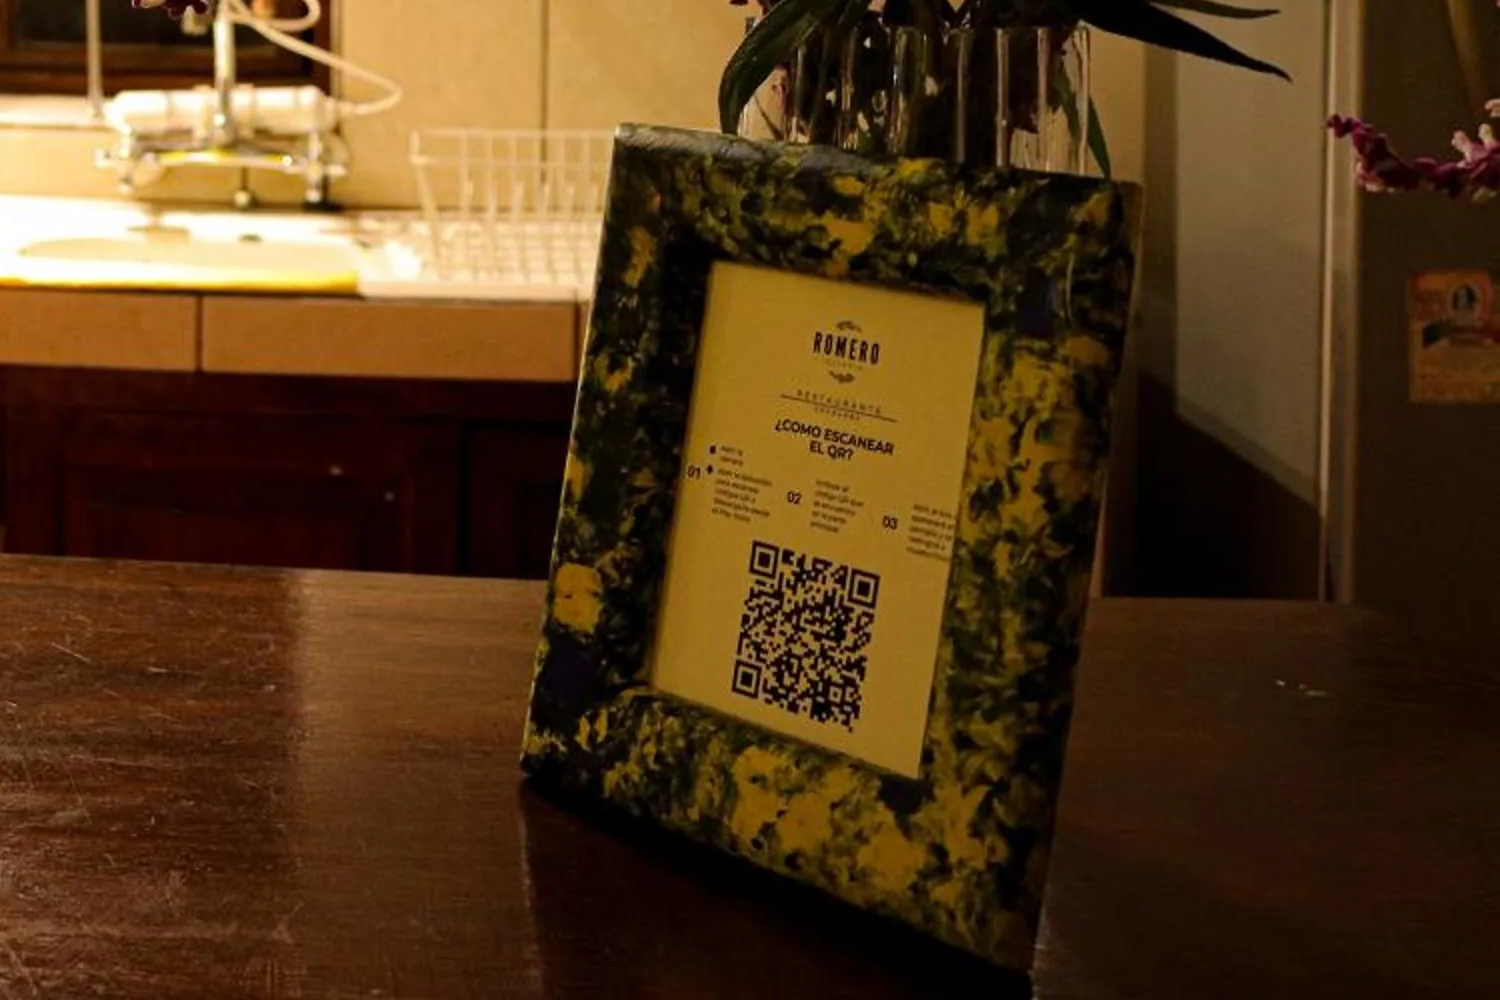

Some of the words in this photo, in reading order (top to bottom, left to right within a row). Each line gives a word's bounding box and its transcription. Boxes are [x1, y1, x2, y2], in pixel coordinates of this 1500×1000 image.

[813, 331, 880, 365] ROMERO
[775, 418, 821, 438] ¿COMO
[824, 428, 895, 456] ESCANEAR
[810, 440, 825, 455] EL
[827, 444, 854, 461] QR?
[687, 464, 701, 479] 01
[787, 491, 803, 505] 02
[882, 514, 898, 531] 03
